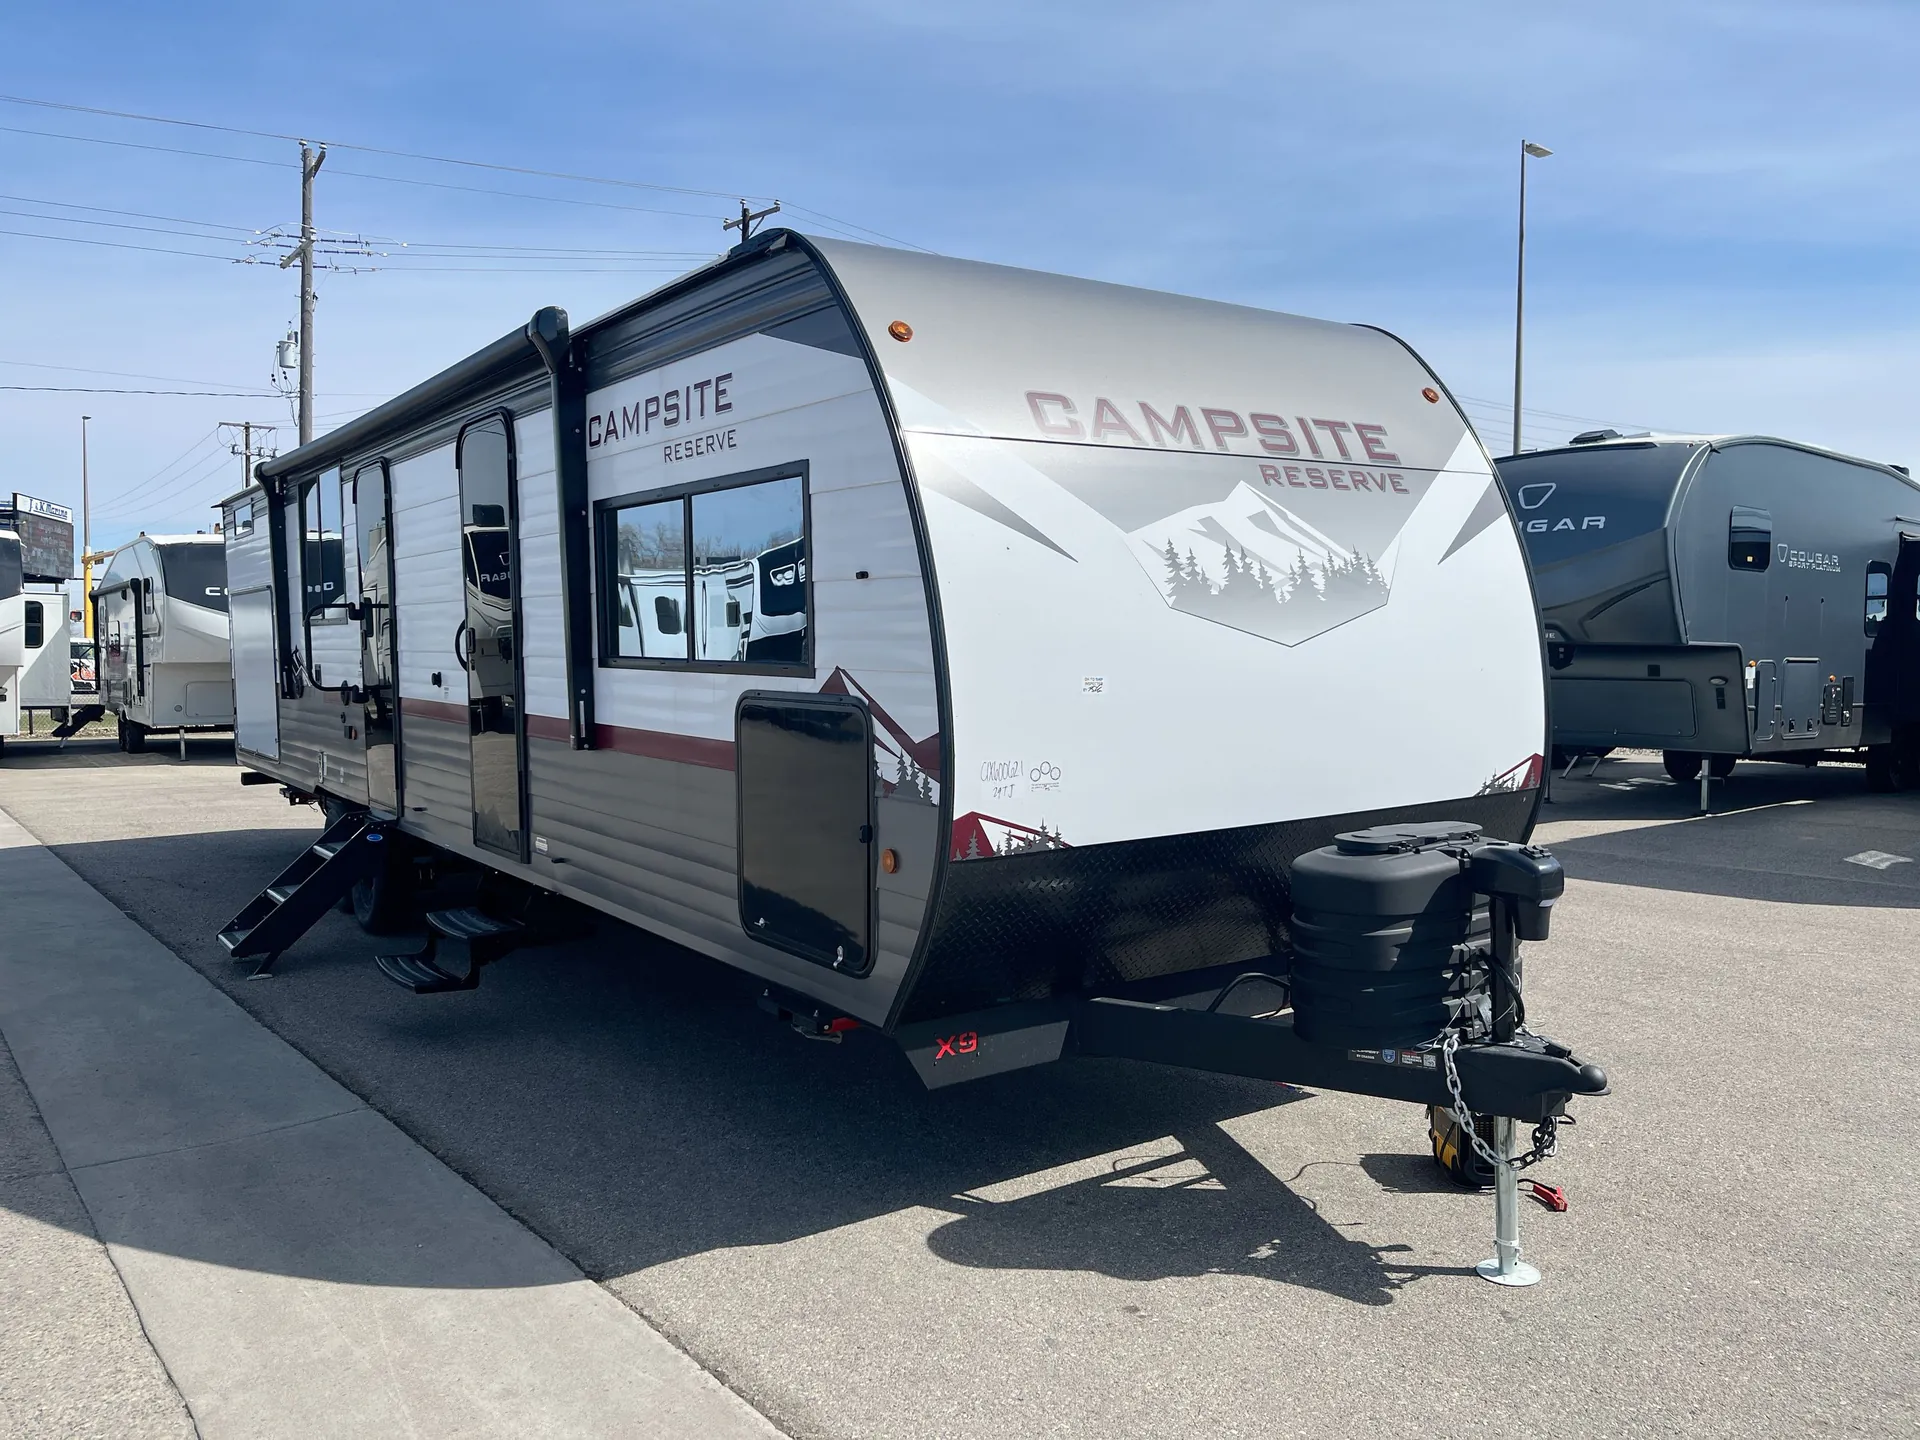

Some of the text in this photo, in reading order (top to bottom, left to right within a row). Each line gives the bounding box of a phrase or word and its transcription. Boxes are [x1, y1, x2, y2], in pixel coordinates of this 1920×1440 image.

[588, 372, 733, 448] CAMPSITE
[1024, 389, 1401, 464] CAMPSITE
[663, 429, 737, 463] RESERVE
[1258, 463, 1410, 495] RESERVE
[1518, 516, 1606, 533] GAR
[1790, 550, 1839, 566] COUGAR
[935, 1031, 978, 1060] X9
